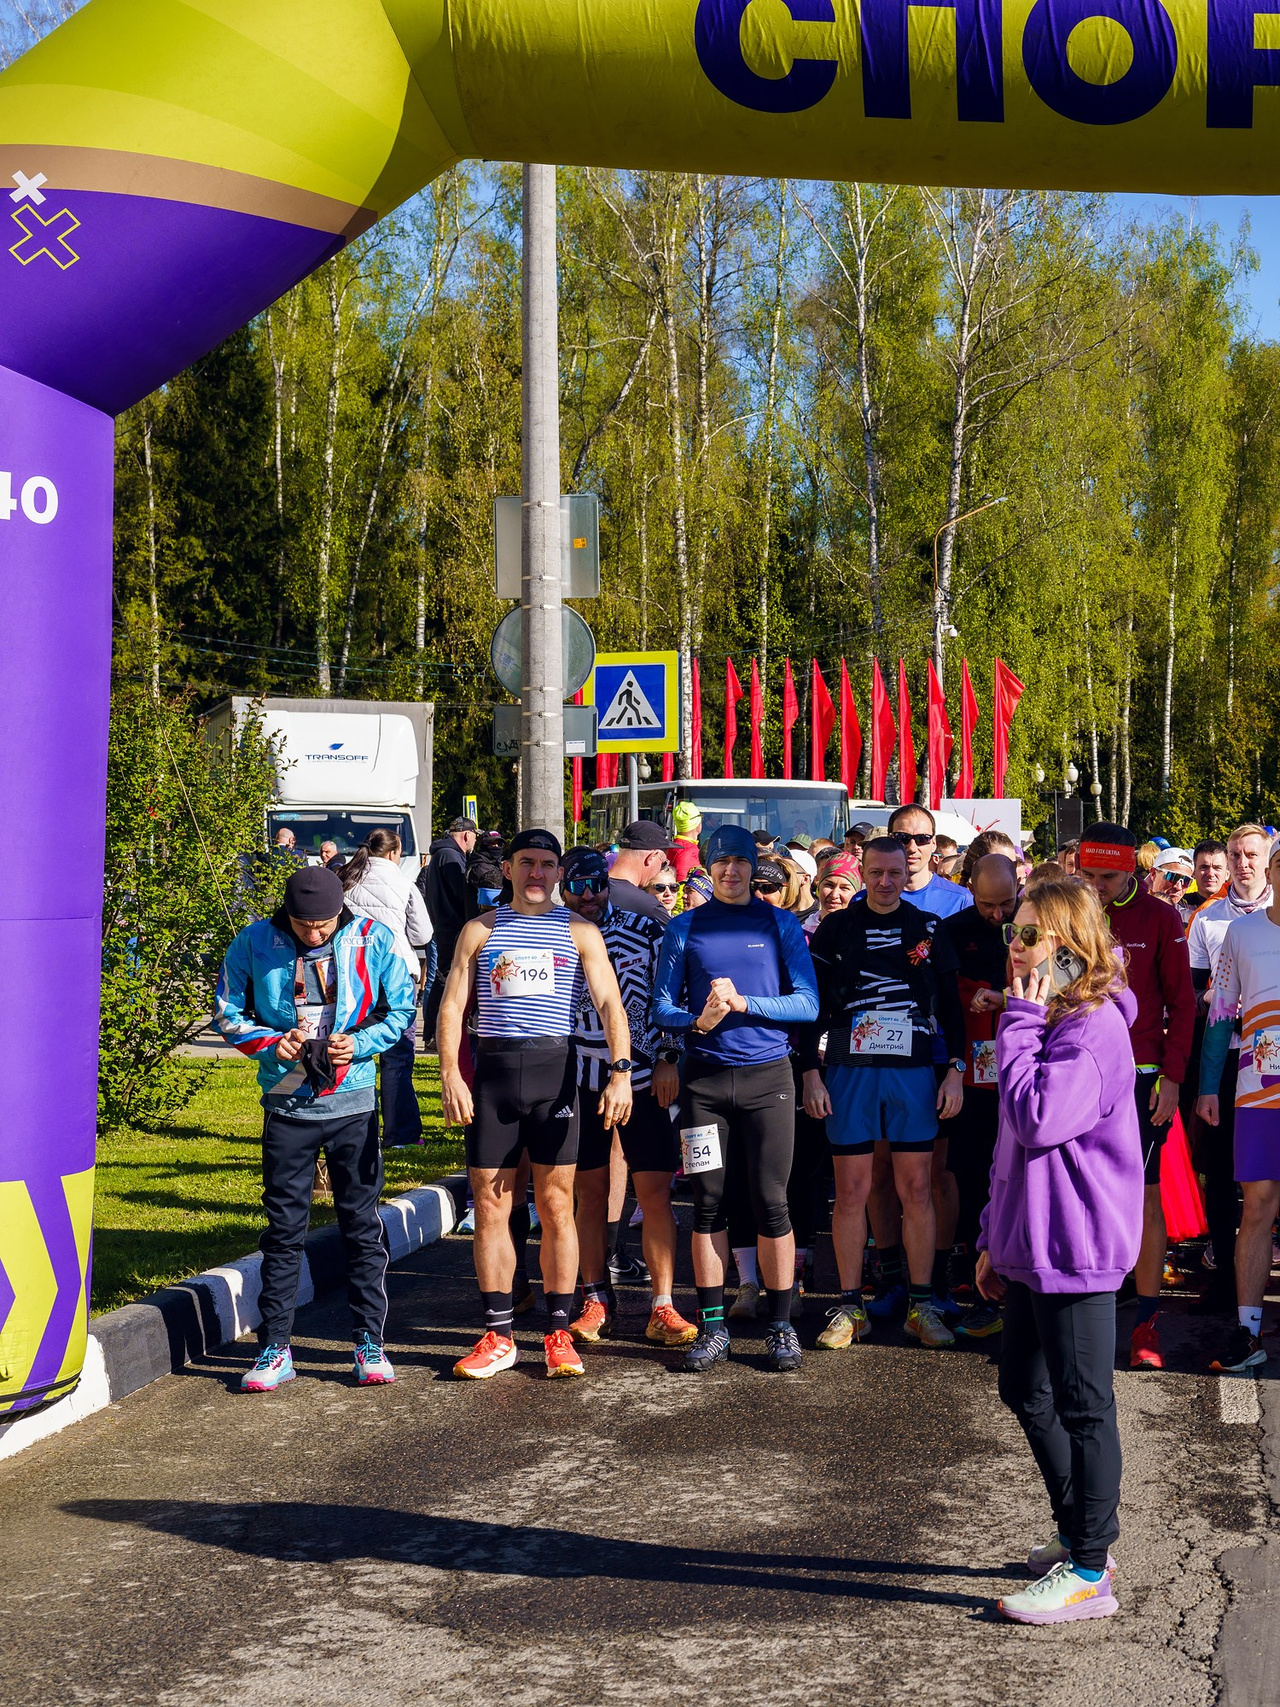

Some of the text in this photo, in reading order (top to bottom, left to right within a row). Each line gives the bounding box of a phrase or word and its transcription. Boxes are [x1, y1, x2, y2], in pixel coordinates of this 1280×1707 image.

[343, 936, 372, 946] РОССИЯ
[520, 968, 548, 981] 196
[887, 1030, 903, 1041] 27
[869, 1042, 904, 1051] Дмитрий
[692, 1145, 711, 1159] 54
[684, 1160, 710, 1168] Степан
